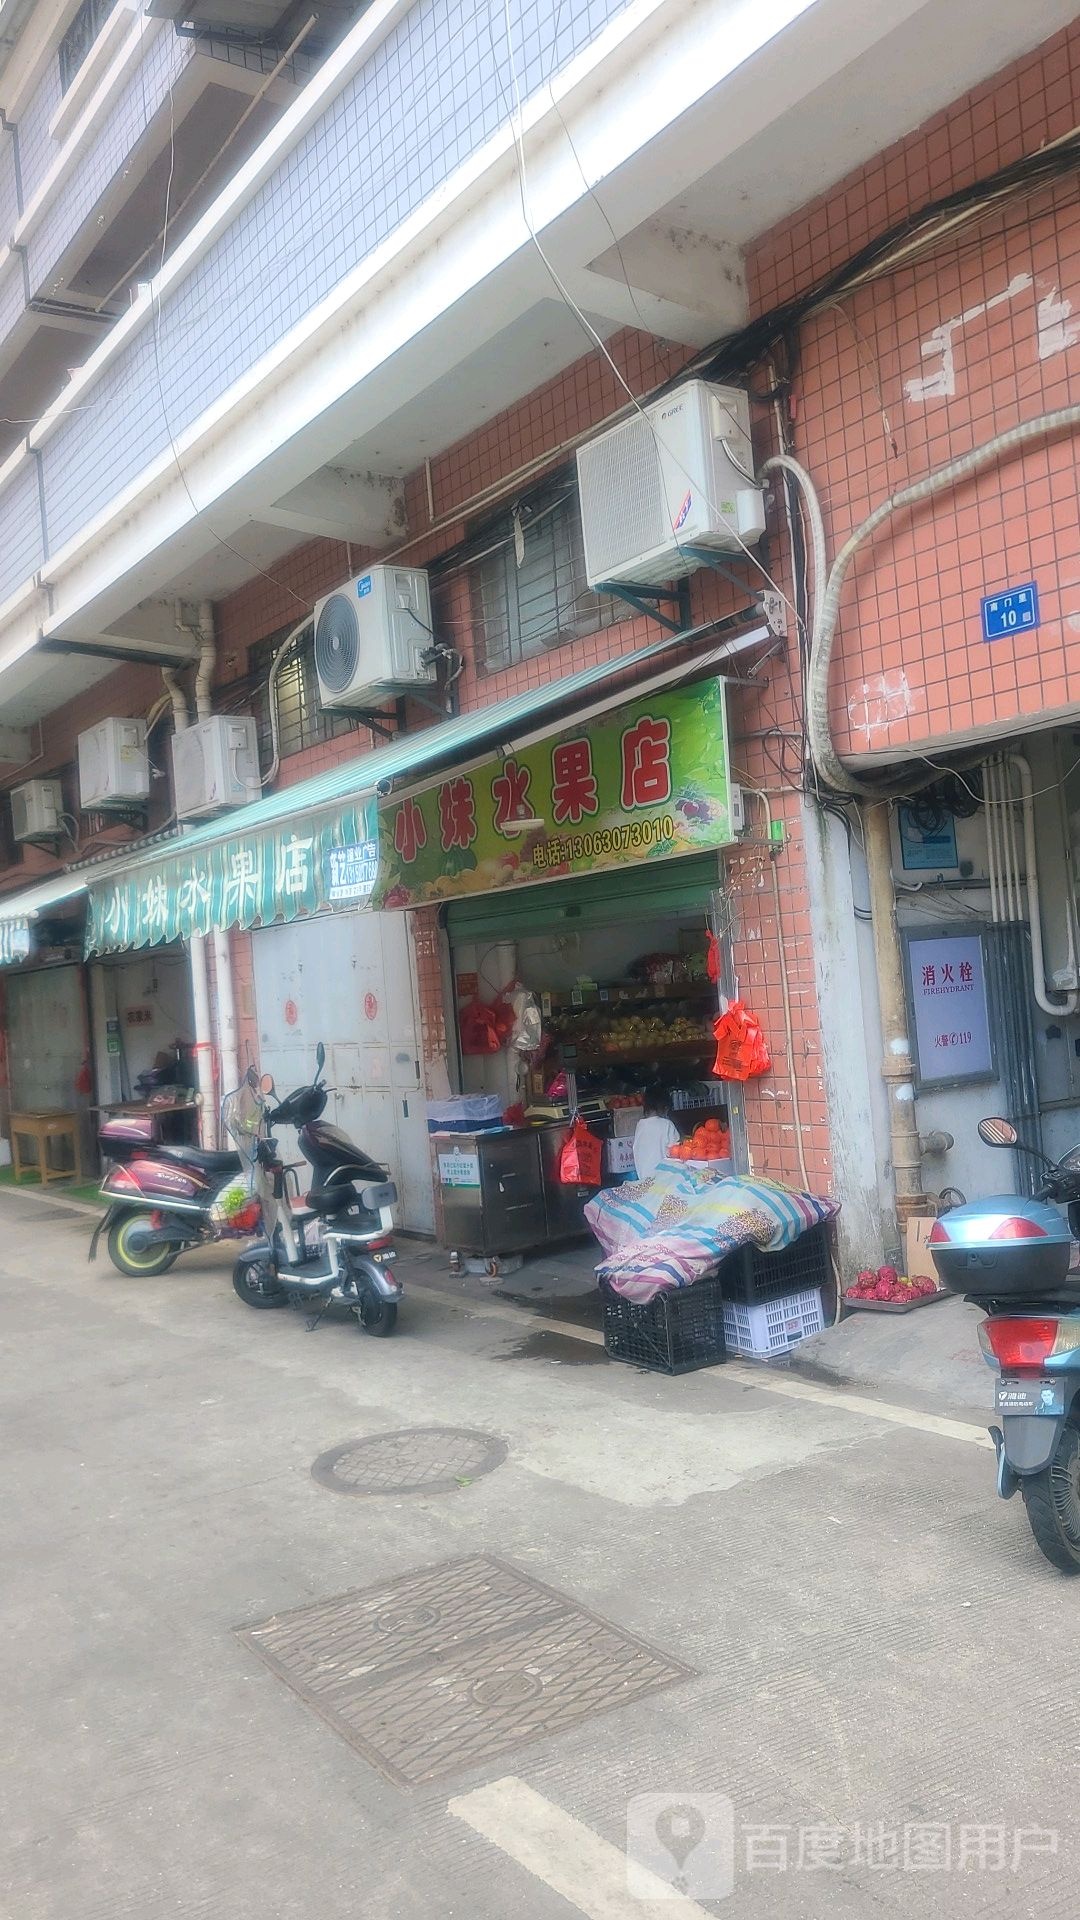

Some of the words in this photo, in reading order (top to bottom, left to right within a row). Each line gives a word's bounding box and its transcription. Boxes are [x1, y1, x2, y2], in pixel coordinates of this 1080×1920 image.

[1001, 610, 1017, 627] 10
[394, 715, 672, 863] 小妹水果店
[922, 962, 973, 986] 消火栓
